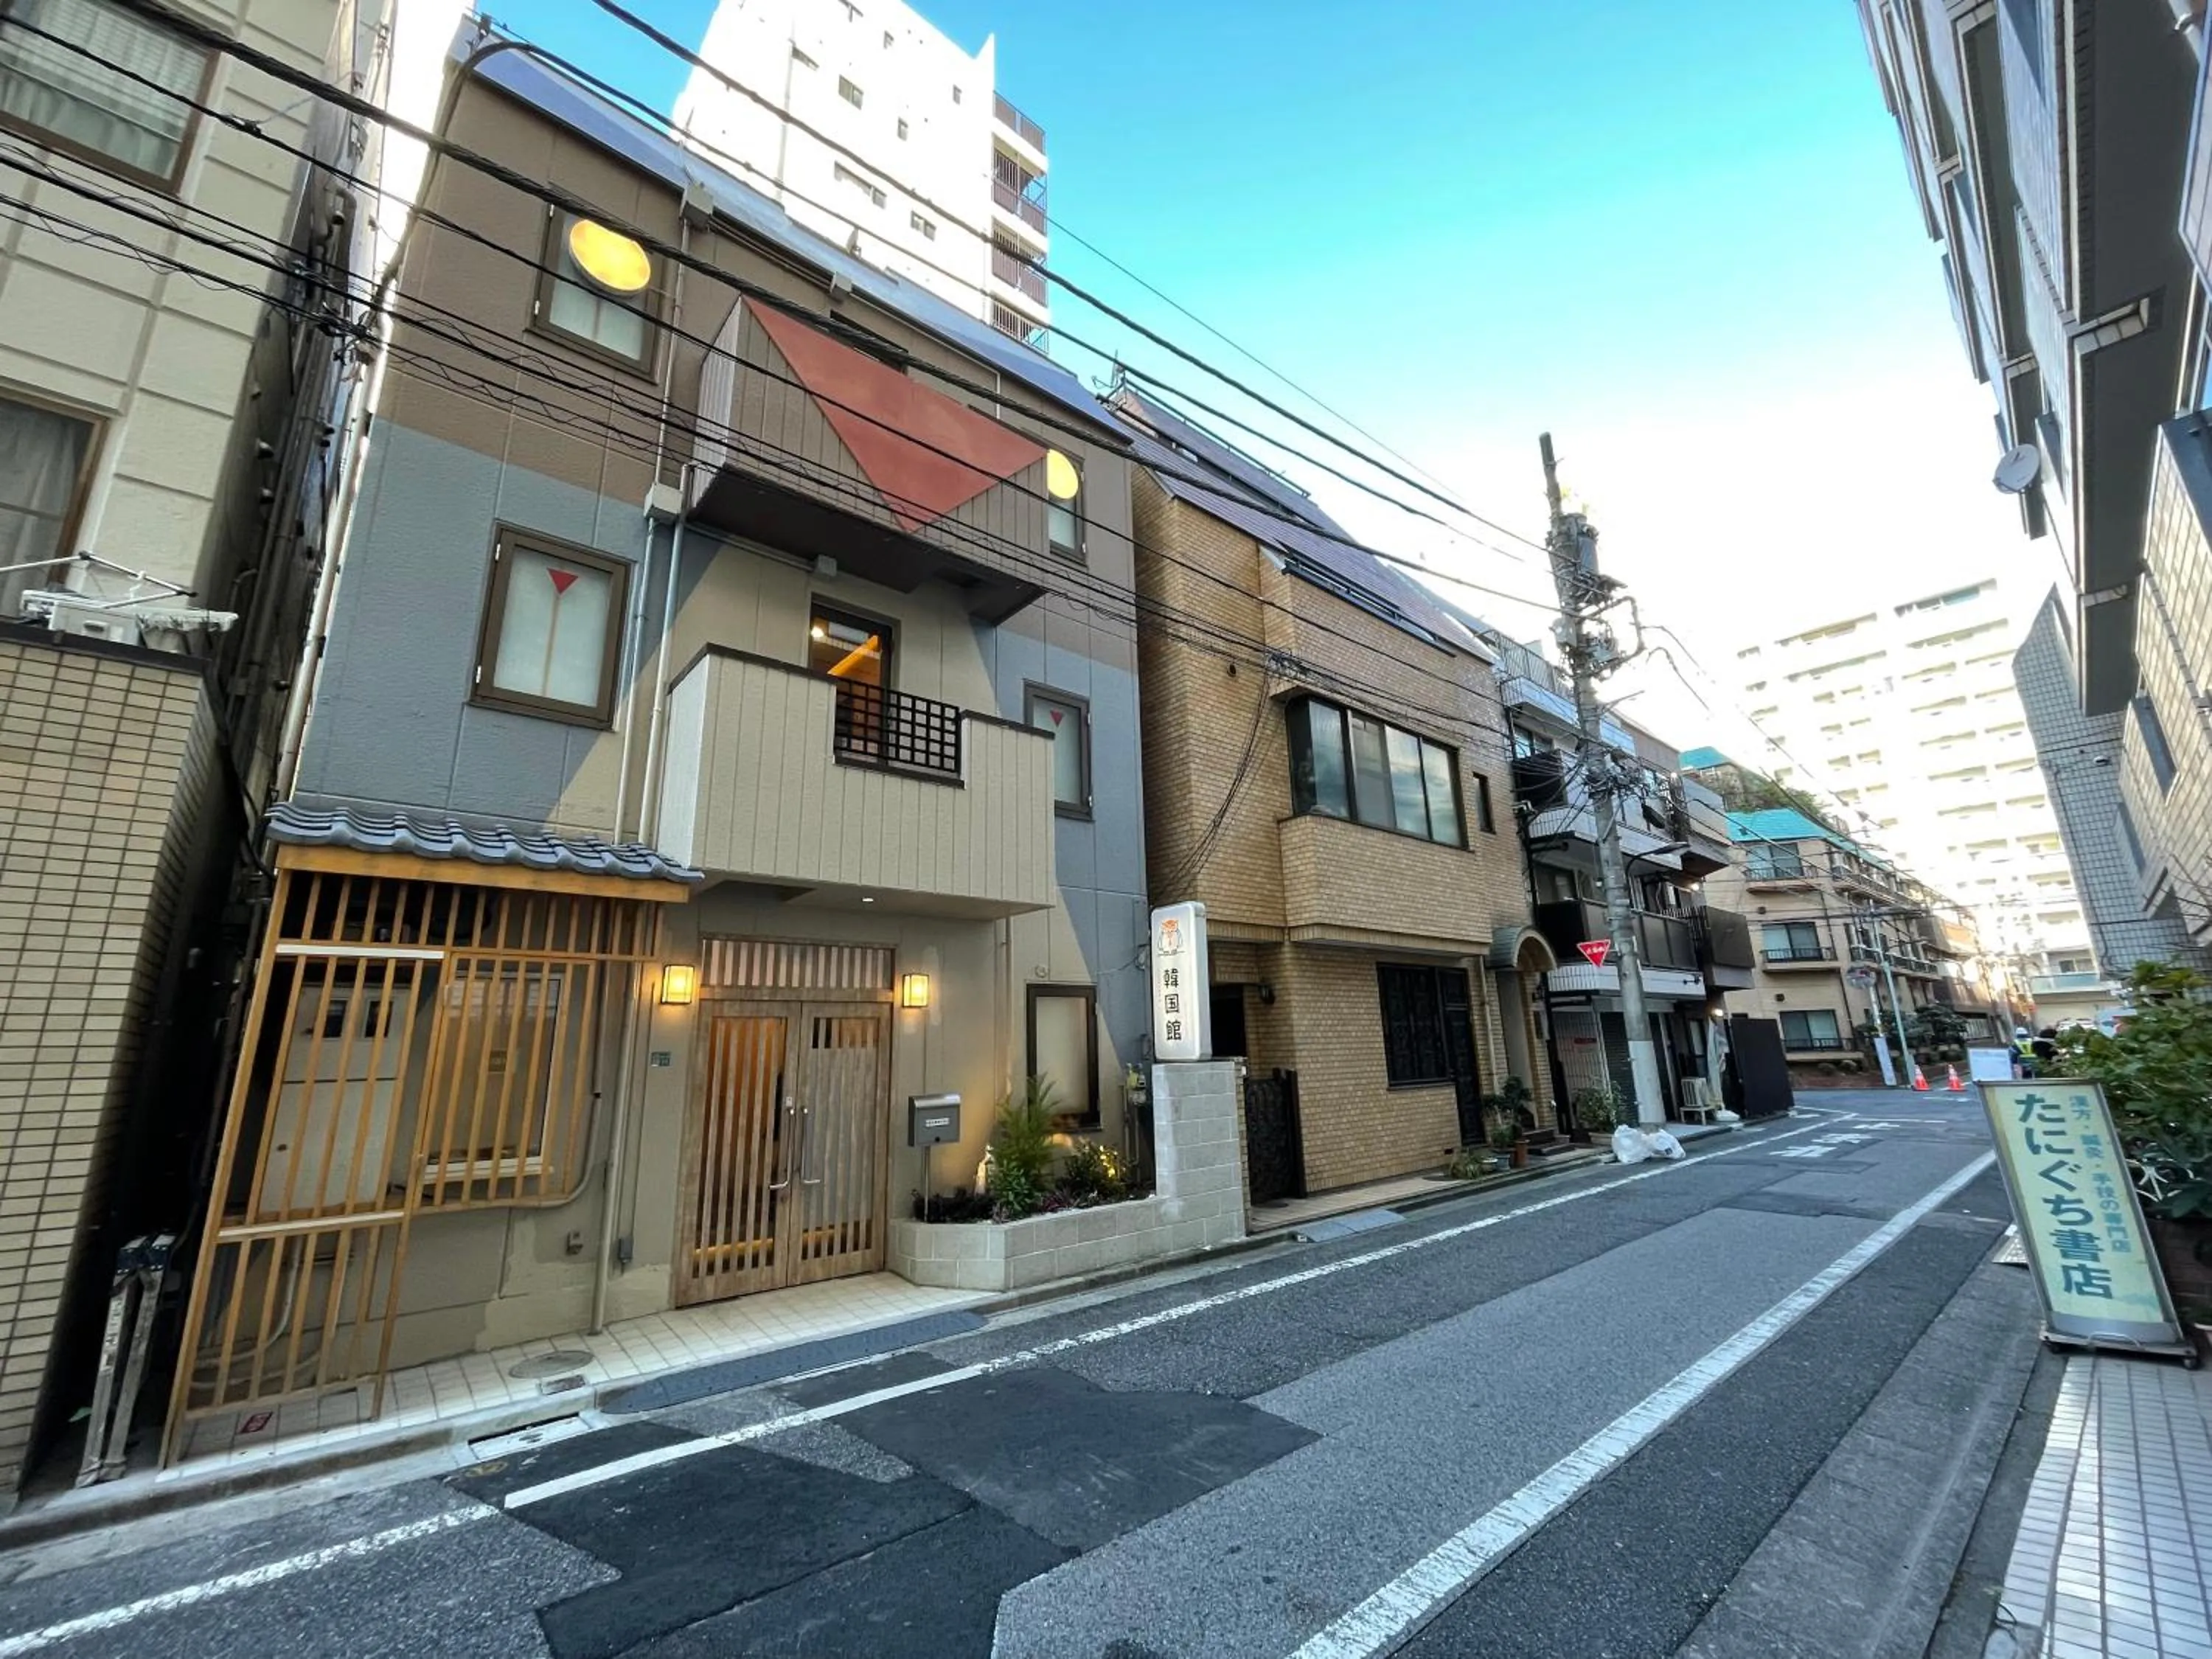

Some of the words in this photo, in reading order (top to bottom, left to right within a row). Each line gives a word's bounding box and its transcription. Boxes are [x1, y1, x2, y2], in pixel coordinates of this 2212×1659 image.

[1164, 968, 1181, 1040] 韓国館
[2015, 1094, 2112, 1299] たにぐち書店
